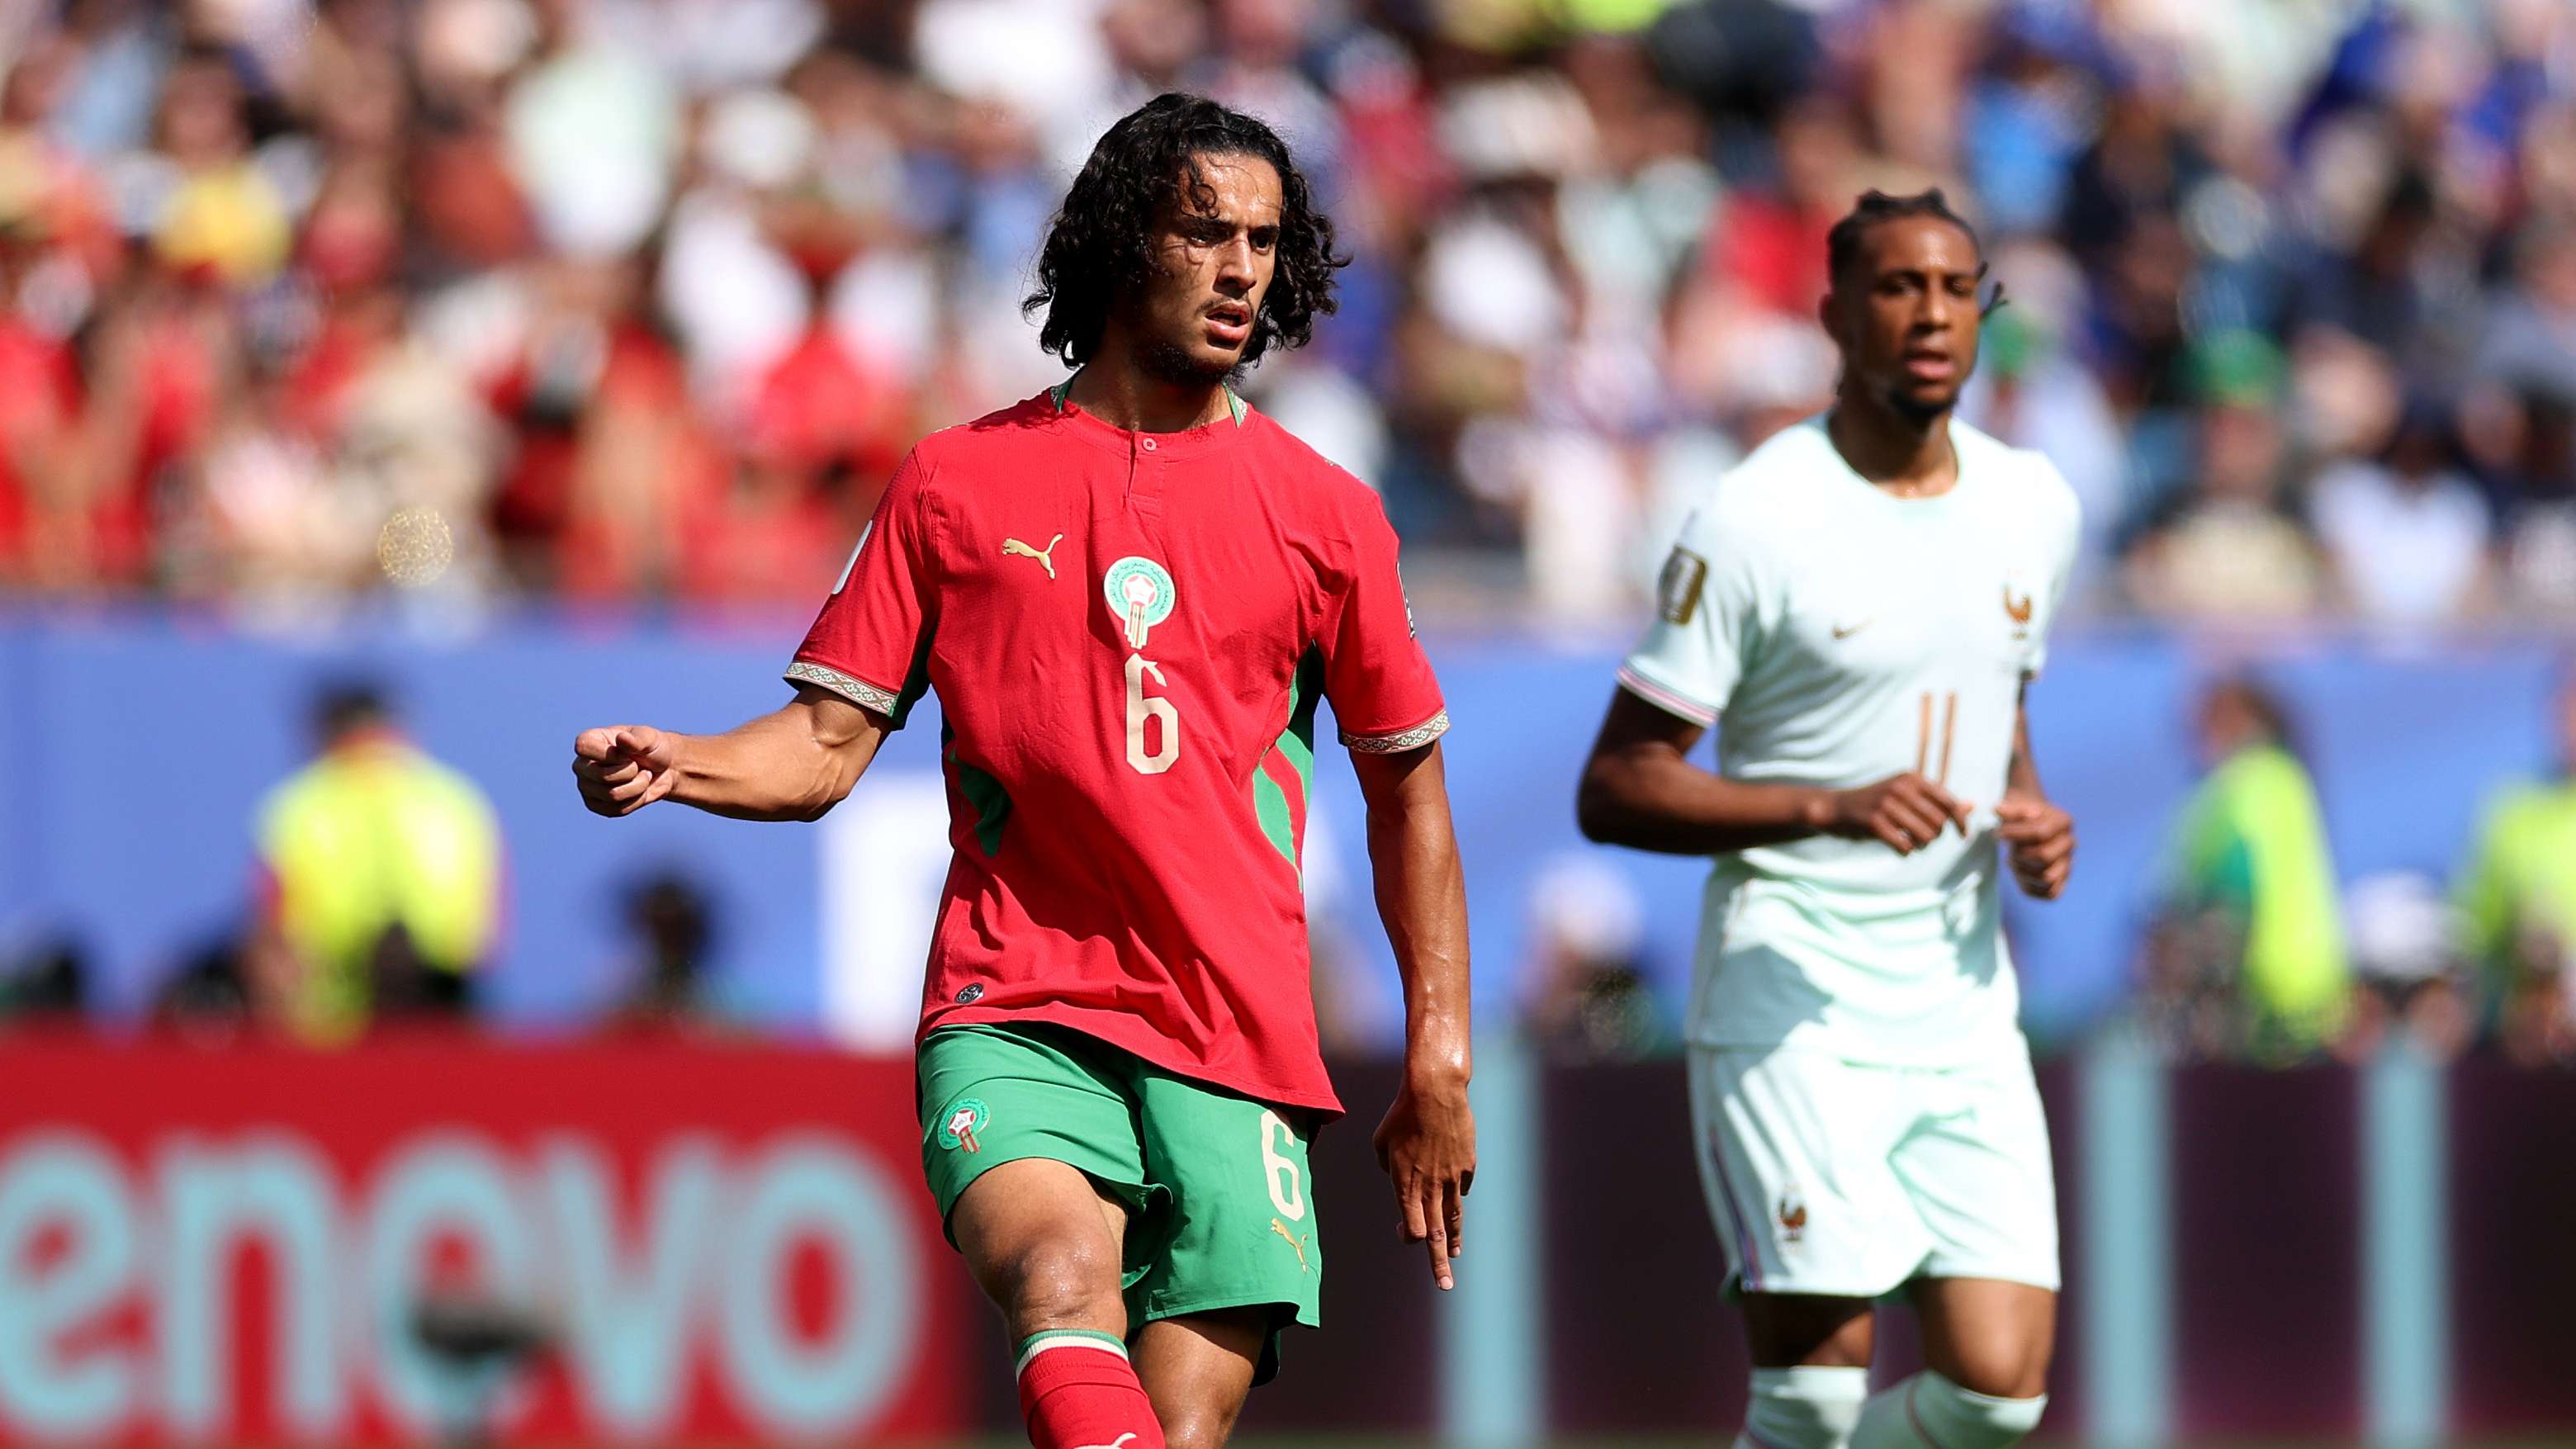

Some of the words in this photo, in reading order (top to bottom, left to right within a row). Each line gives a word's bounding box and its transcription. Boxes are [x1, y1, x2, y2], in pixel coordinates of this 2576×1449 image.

[1125, 652, 1179, 774] 6
[1918, 692, 1958, 785] 11
[1261, 1110, 1305, 1220] 6
